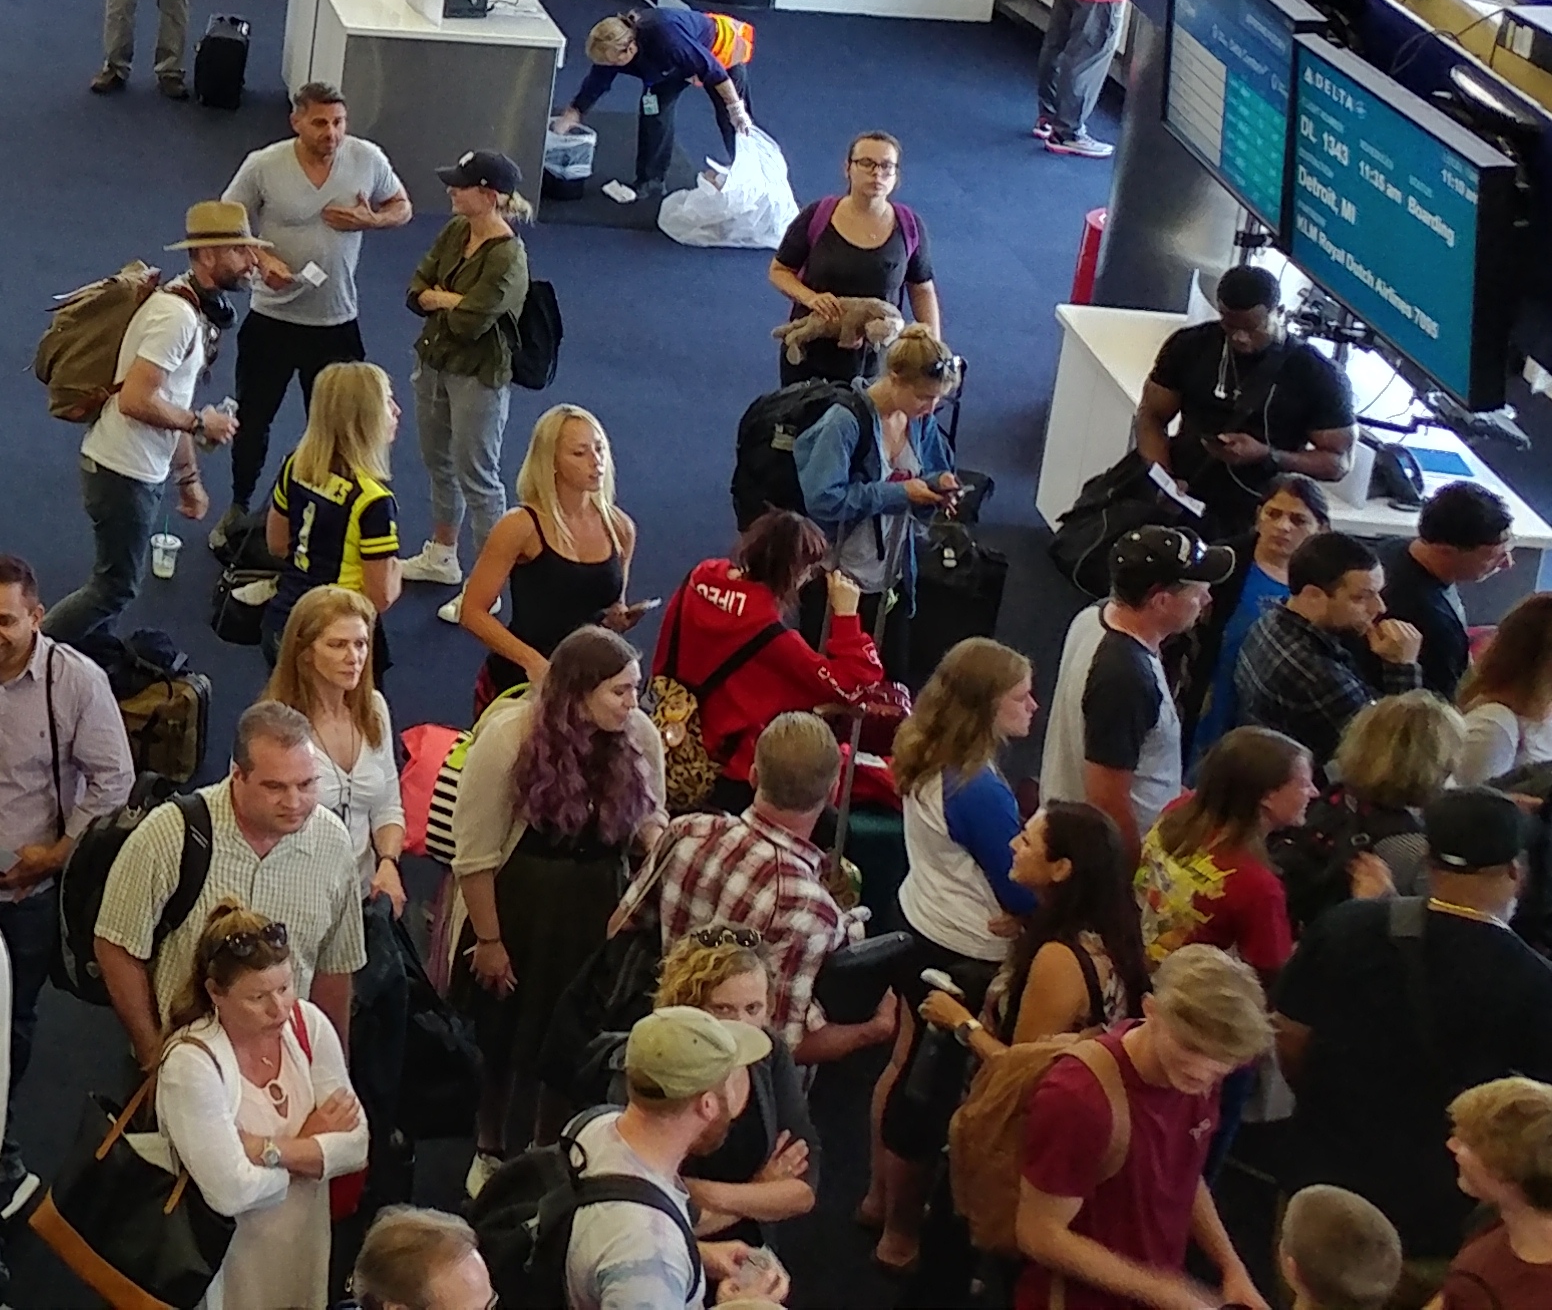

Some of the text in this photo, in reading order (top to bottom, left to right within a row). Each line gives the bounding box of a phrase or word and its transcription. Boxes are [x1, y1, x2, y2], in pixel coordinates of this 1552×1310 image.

[1314, 72, 1354, 113] DELTA
[1299, 115, 1318, 144] DL
[1322, 131, 1350, 167] 1343
[1298, 163, 1339, 216] Detroit,
[1340, 197, 1357, 226] MI
[1385, 182, 1403, 205] am
[1407, 195, 1456, 249] Boarding
[1296, 213, 1319, 242] KLM
[1318, 231, 1347, 266] Royal
[1346, 252, 1375, 289] Dutch
[1374, 277, 1413, 320] Airlines
